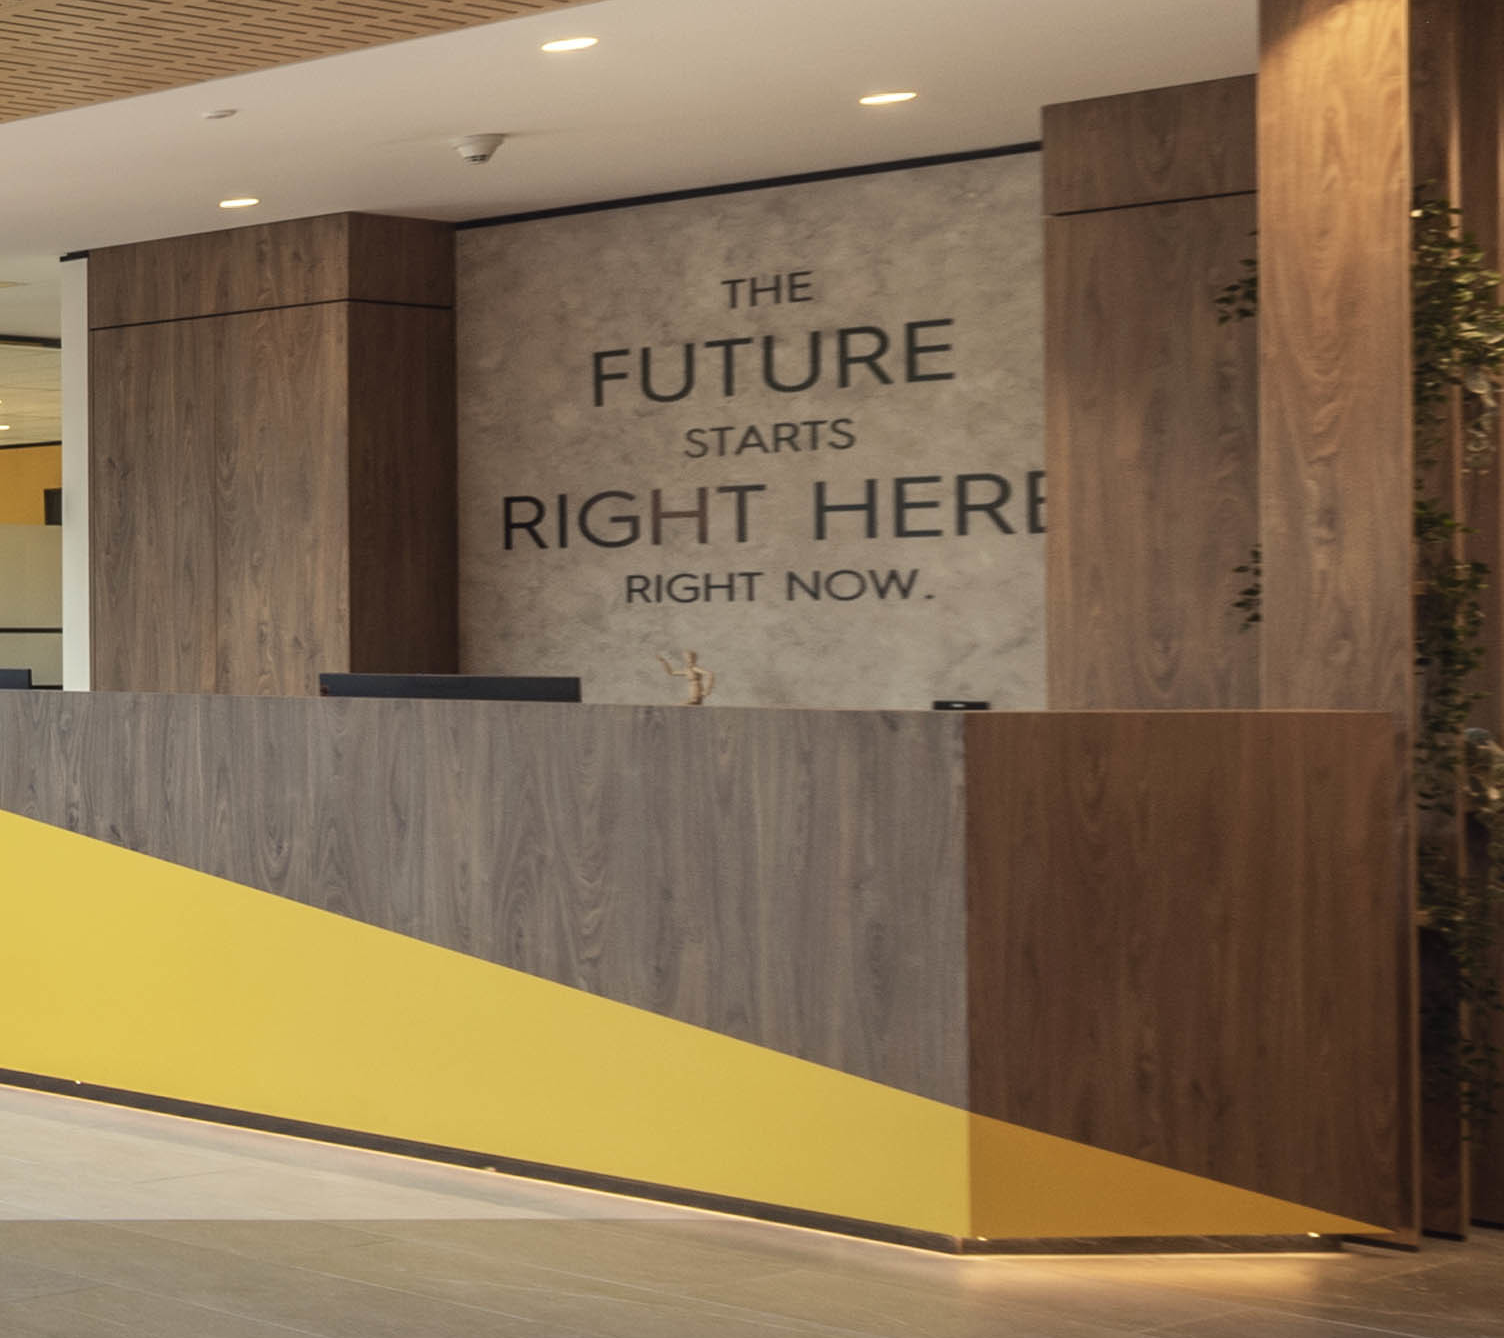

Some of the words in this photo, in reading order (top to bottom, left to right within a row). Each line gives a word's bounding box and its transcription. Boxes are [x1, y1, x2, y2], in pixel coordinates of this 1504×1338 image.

[720, 269, 814, 310] THE
[590, 318, 957, 409] FUTURE
[683, 417, 857, 459] STARTS
[500, 482, 768, 552] RIGHT
[624, 570, 765, 605] RIGHT
[786, 568, 936, 604] NOW.
